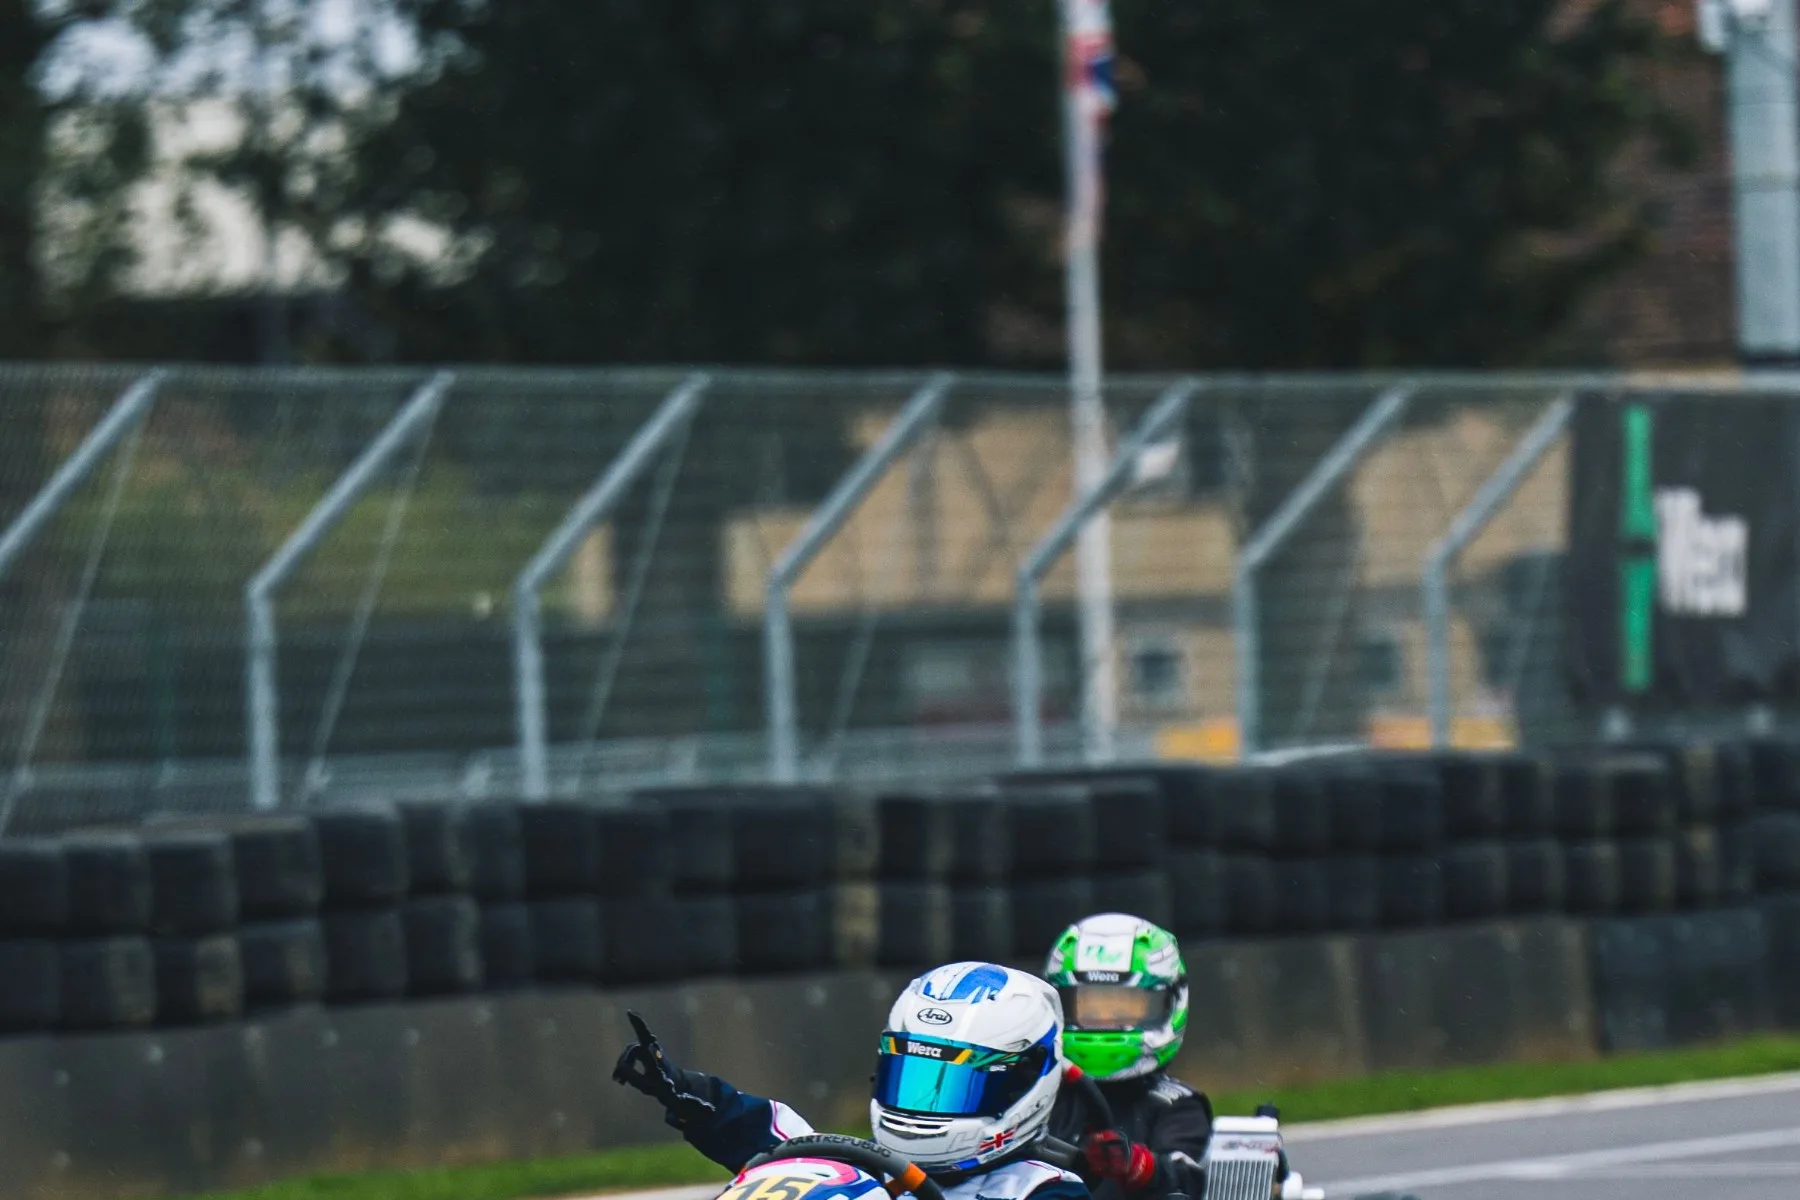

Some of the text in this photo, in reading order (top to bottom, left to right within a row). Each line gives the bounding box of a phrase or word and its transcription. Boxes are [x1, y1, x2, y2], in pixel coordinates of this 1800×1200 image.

[1088, 972, 1120, 983] Wera
[924, 1008, 948, 1021] Arai
[906, 1041, 942, 1058] Wera
